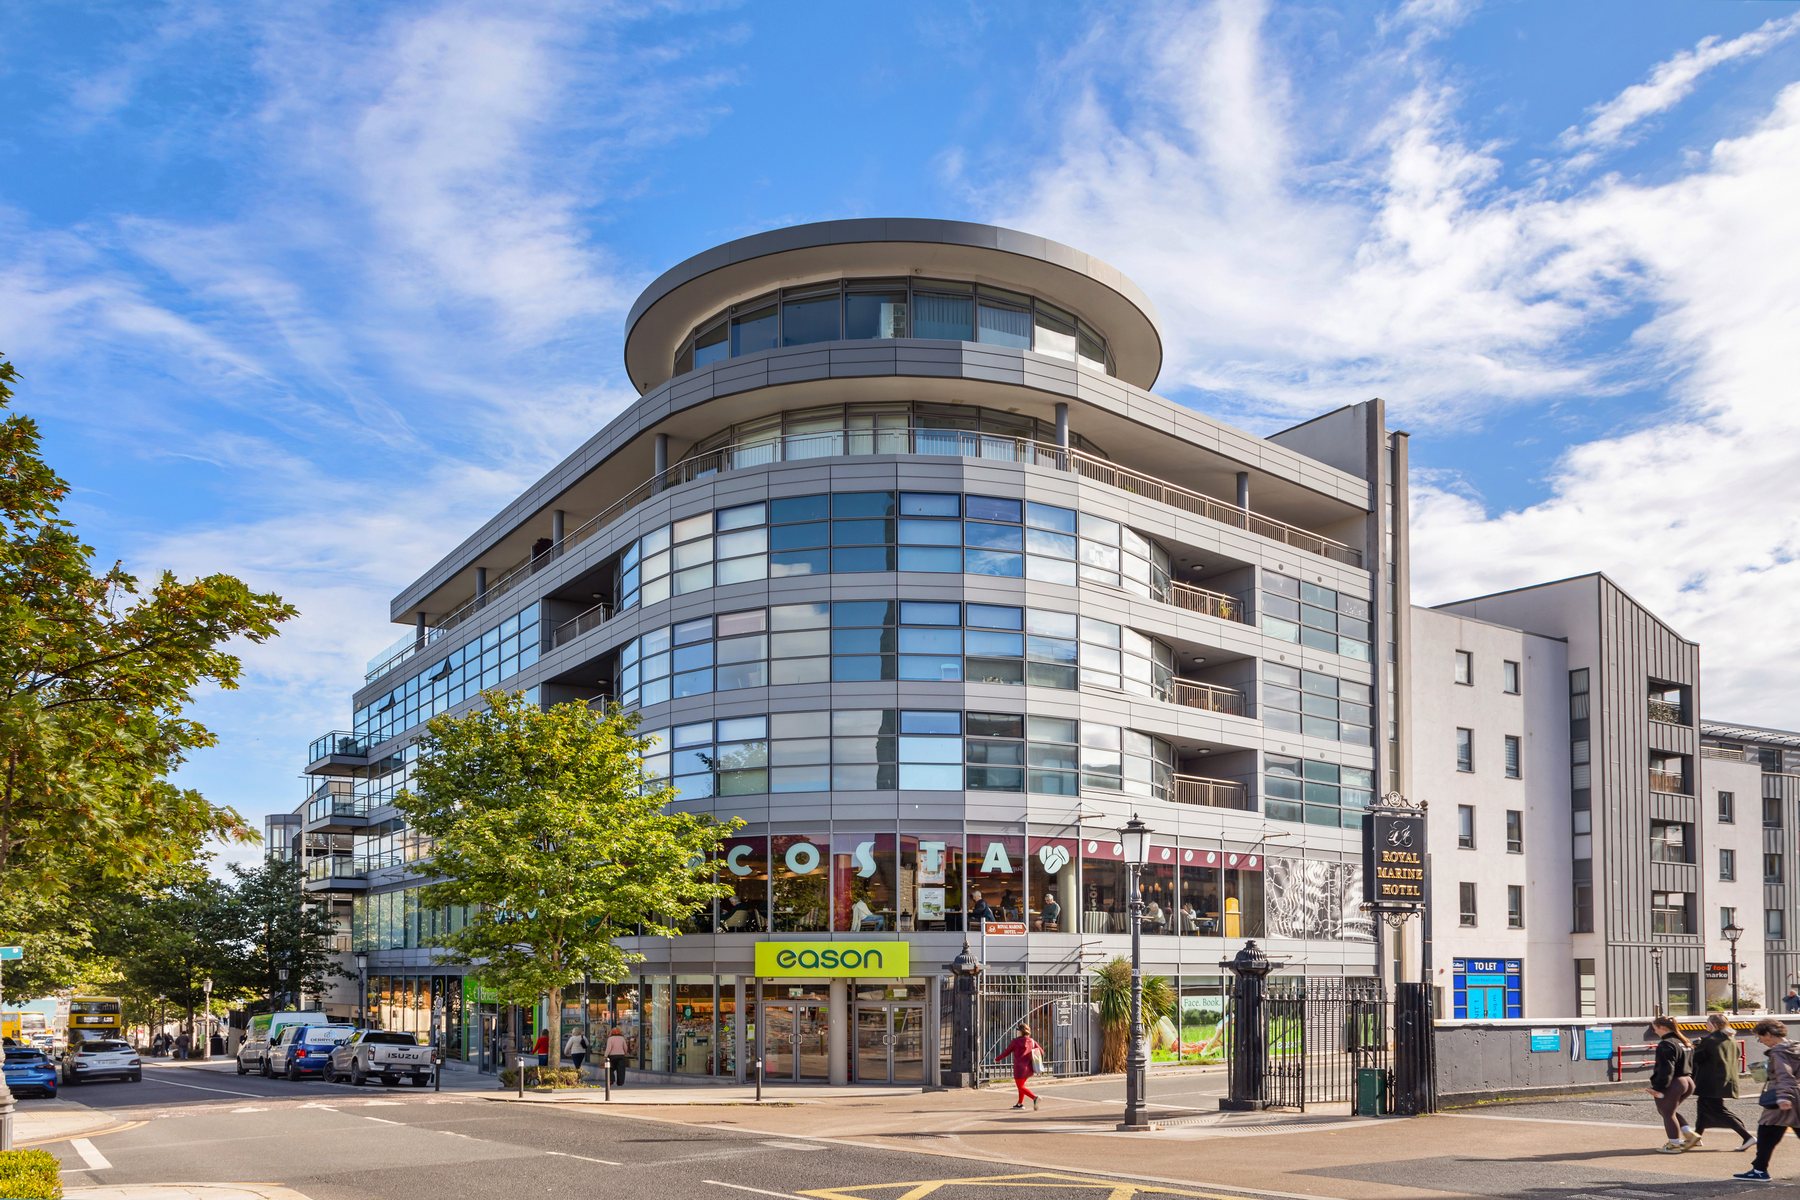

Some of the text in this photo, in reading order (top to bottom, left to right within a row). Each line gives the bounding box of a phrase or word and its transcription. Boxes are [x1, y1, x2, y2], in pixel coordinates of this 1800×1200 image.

[727, 841, 1014, 878] COSTA
[1382, 850, 1420, 864] ROYAL
[1377, 867, 1423, 880] MARINE
[1382, 884, 1420, 896] HOTEL
[776, 949, 883, 969] eason
[1474, 962, 1497, 971] TO LET
[1184, 999, 1221, 1007] Face. Book.
